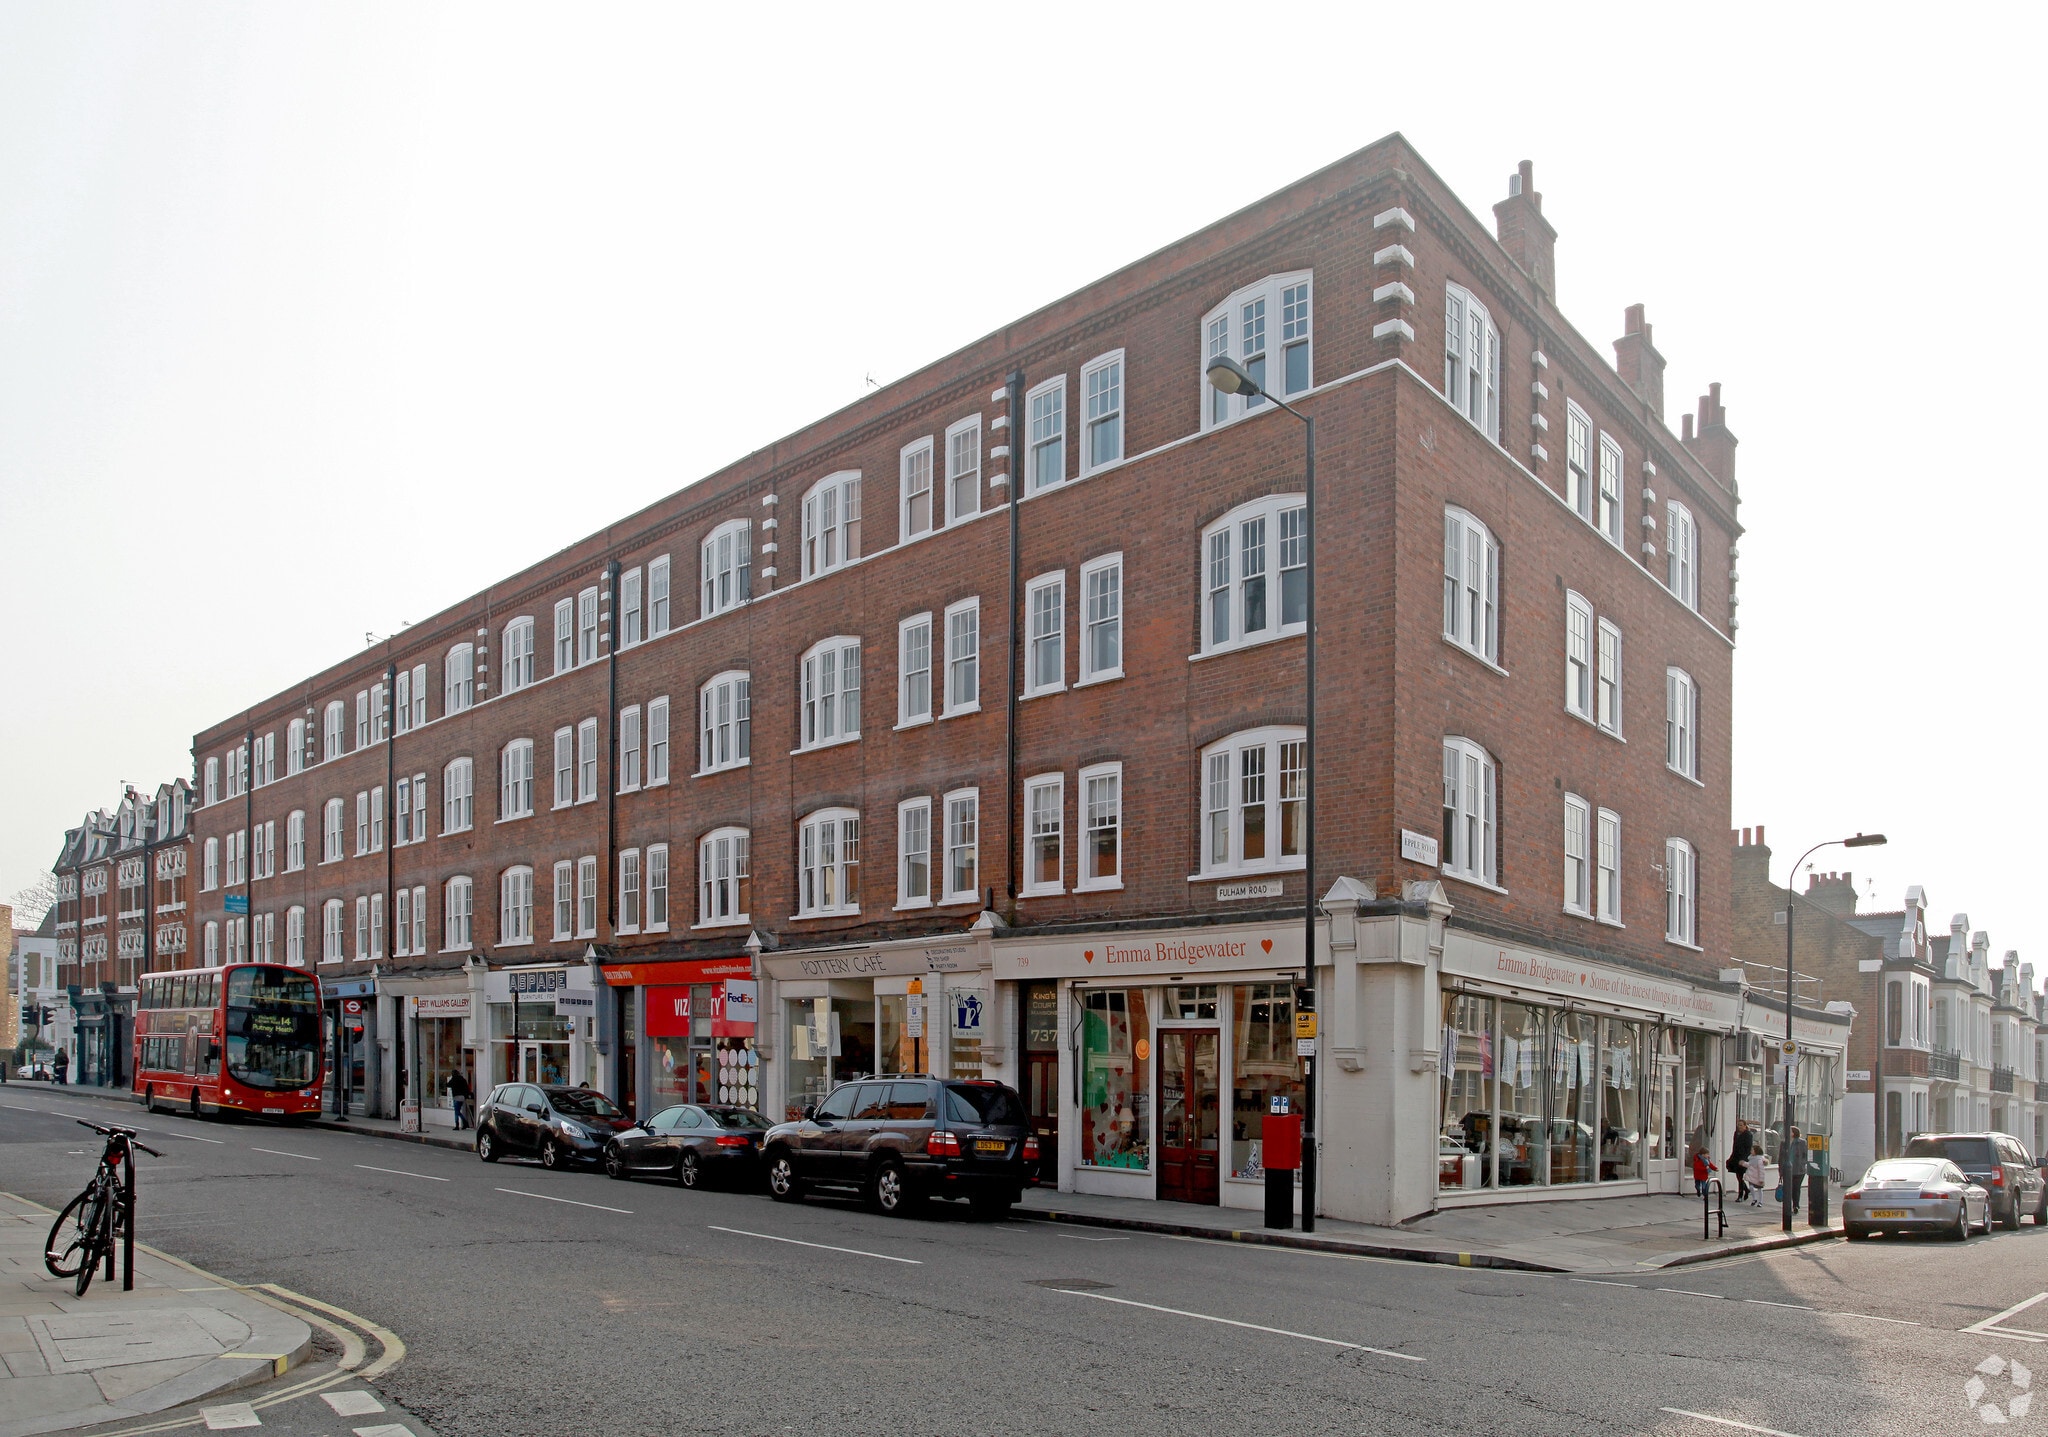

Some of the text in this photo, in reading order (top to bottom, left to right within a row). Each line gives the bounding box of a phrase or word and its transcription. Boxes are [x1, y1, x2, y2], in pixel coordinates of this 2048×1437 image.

[1404, 837, 1420, 850] EPPLE
[1421, 842, 1436, 854] ROAD
[1219, 887, 1246, 897] FULHAM
[1248, 885, 1267, 895] ROAD
[1105, 941, 1246, 965] Emma Bridgewater
[801, 953, 886, 975] POTTERY CAFÉ
[1017, 957, 1029, 967] 739
[1497, 951, 1528, 975] Emma
[1529, 958, 1576, 985] Bridgewater
[1589, 971, 1610, 991] Some
[1611, 977, 1620, 993] of
[1620, 979, 1631, 996] the
[1631, 982, 1651, 1000] nicest
[1651, 988, 1671, 1007] things
[1671, 992, 1678, 1004] in
[1678, 997, 1692, 1011] your
[727, 992, 753, 1004] FedEx
[1033, 991, 1056, 1000] KING'S
[430, 999, 450, 1008] WILLIAMS
[451, 998, 469, 1007] GALLERY
[1033, 1001, 1056, 1009] COURT
[281, 1017, 291, 1026] 14
[252, 1023, 293, 1033] Putney Heath
[625, 1030, 634, 1040] 72
[1031, 1029, 1058, 1042] 737
[1273, 1096, 1279, 1106] P
[1282, 1097, 1288, 1106] P
